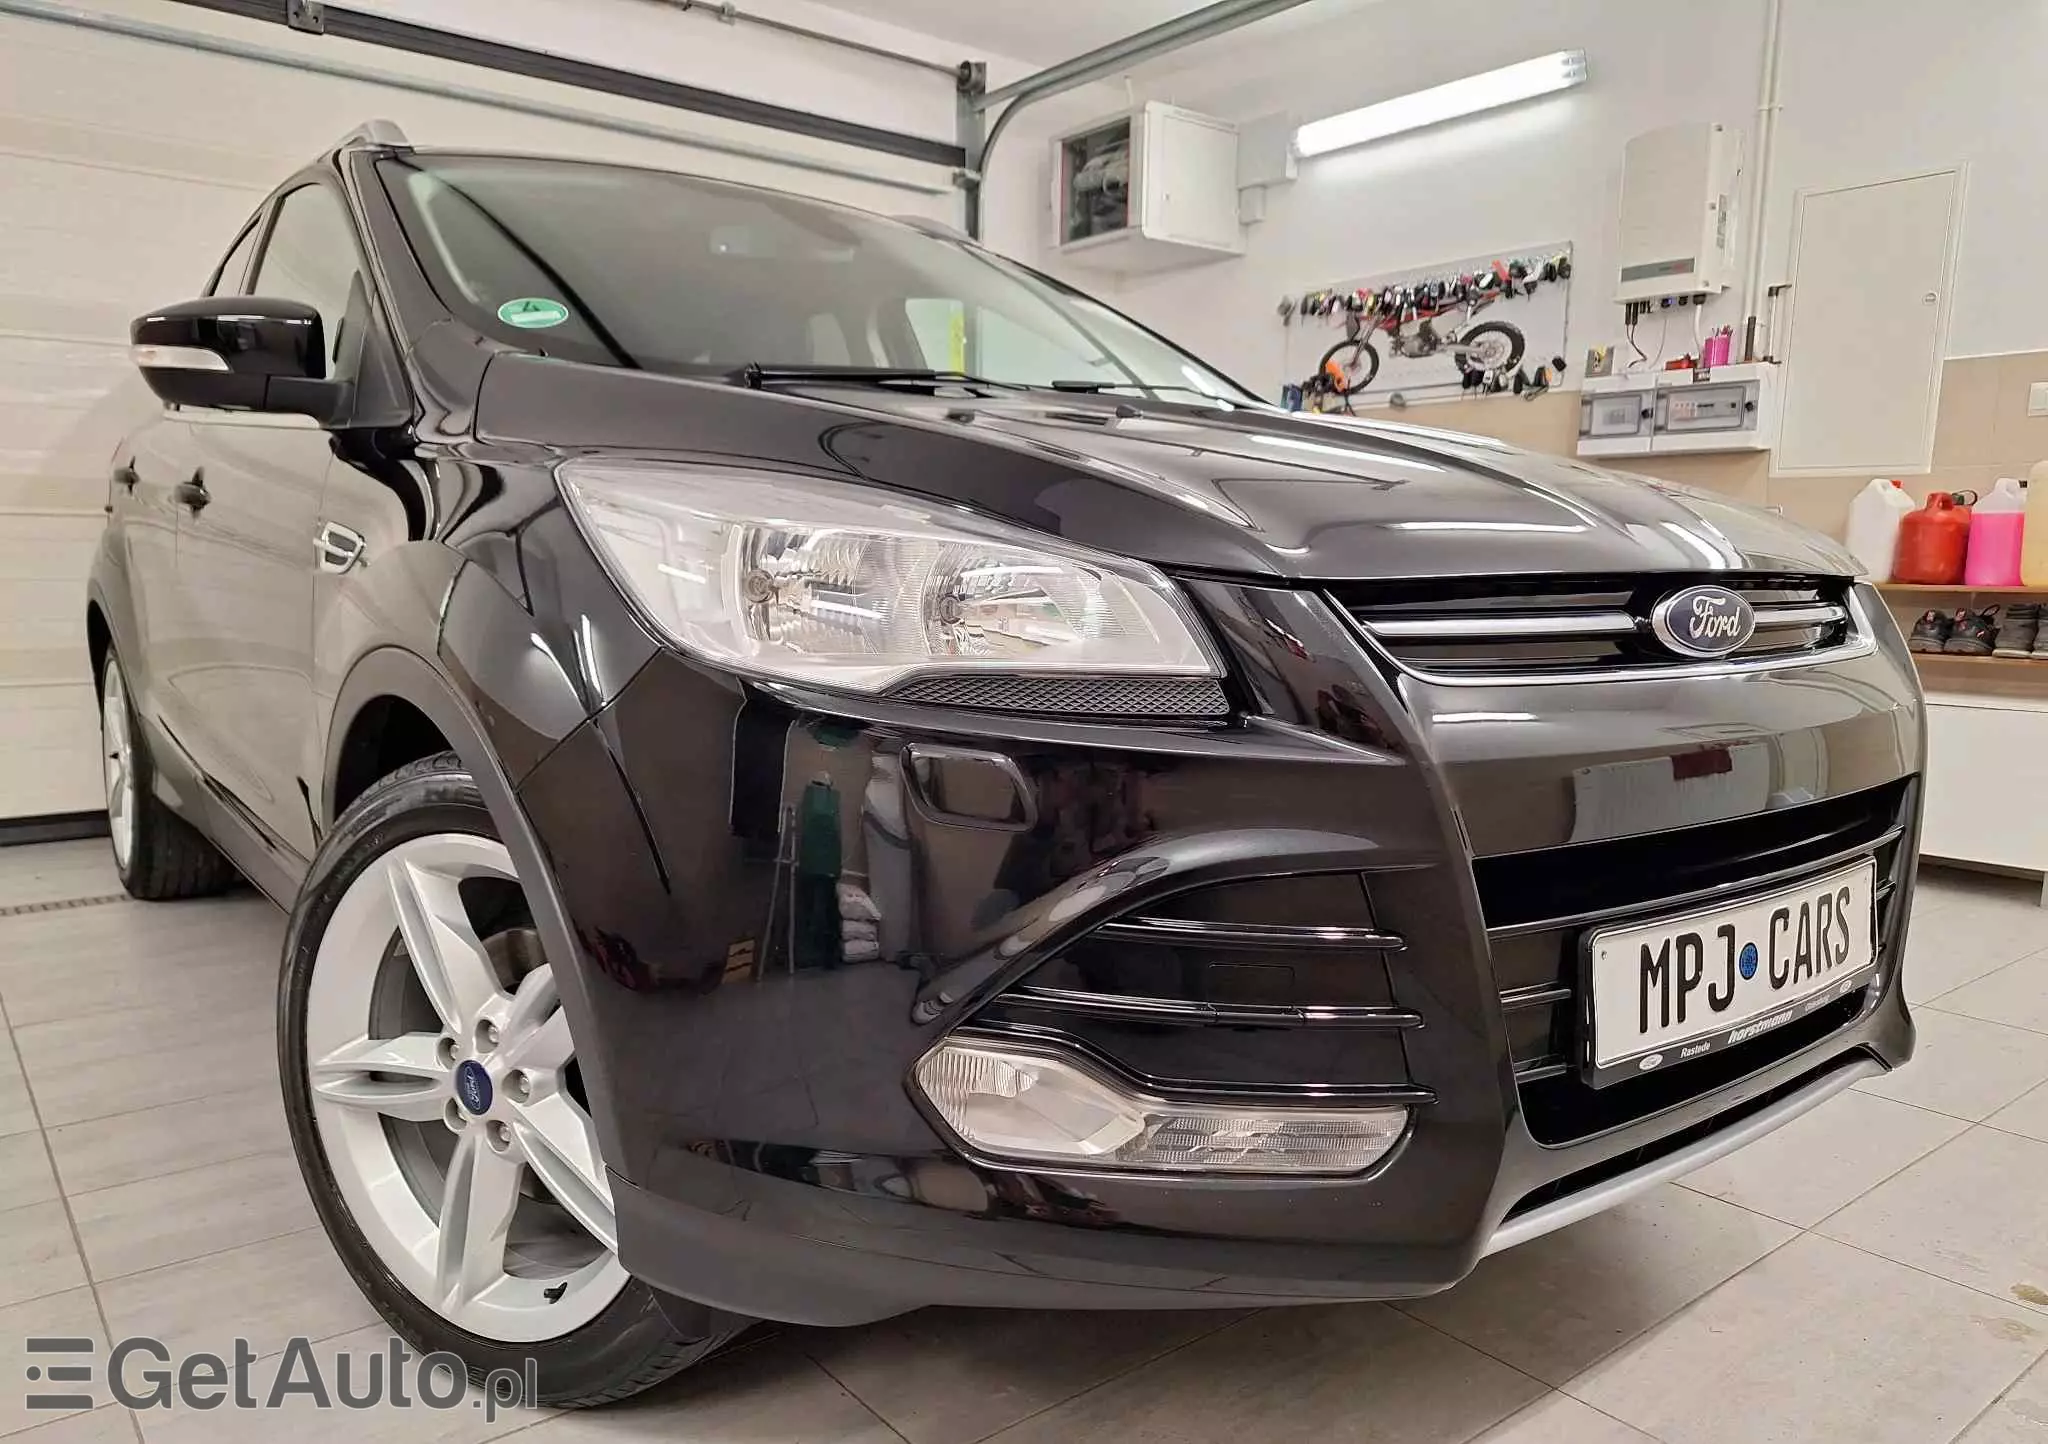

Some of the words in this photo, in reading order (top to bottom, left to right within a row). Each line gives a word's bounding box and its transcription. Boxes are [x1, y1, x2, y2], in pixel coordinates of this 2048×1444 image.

[1689, 595, 1741, 640] Ford
[1639, 923, 1736, 1034] MPJ
[1768, 886, 1850, 990] CARS
